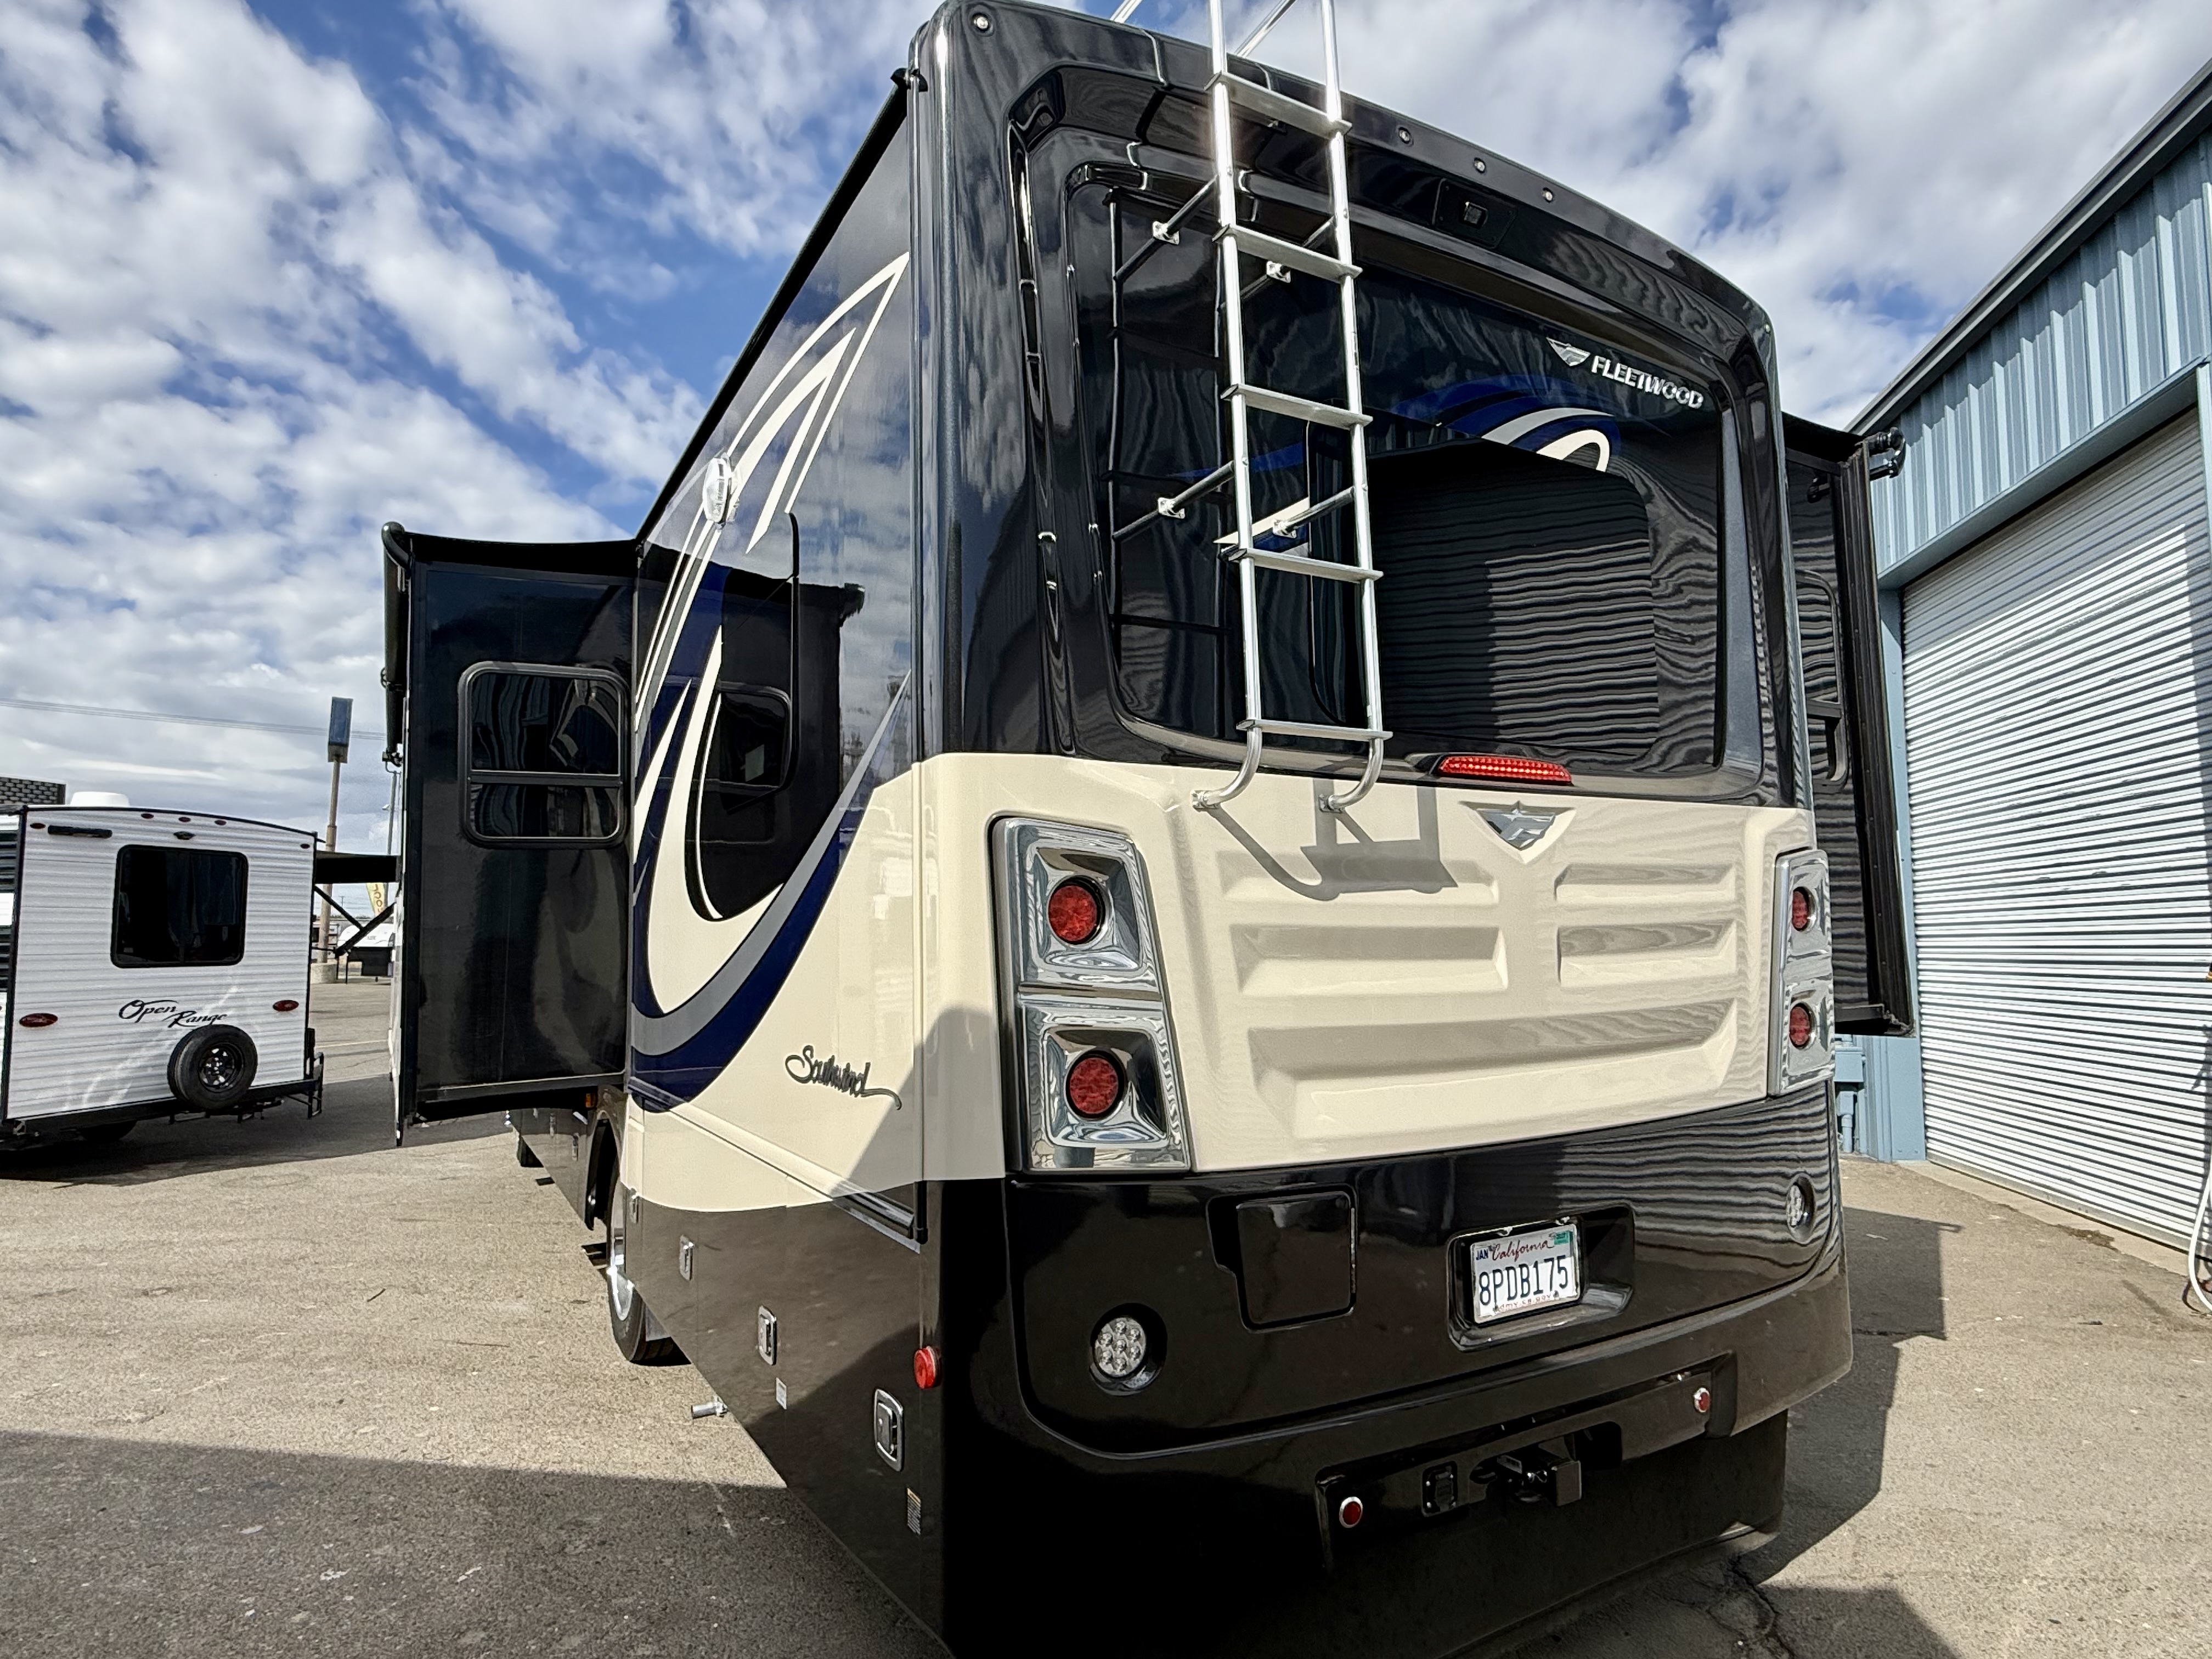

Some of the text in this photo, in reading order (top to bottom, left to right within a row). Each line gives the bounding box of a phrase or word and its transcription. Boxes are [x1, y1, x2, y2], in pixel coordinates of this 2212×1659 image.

[1592, 356, 1703, 409] FLEETWOOD
[119, 1000, 228, 1028] Open Range
[1476, 1240, 1555, 1262] JAN California
[1479, 1255, 1568, 1306] 8PDB175
